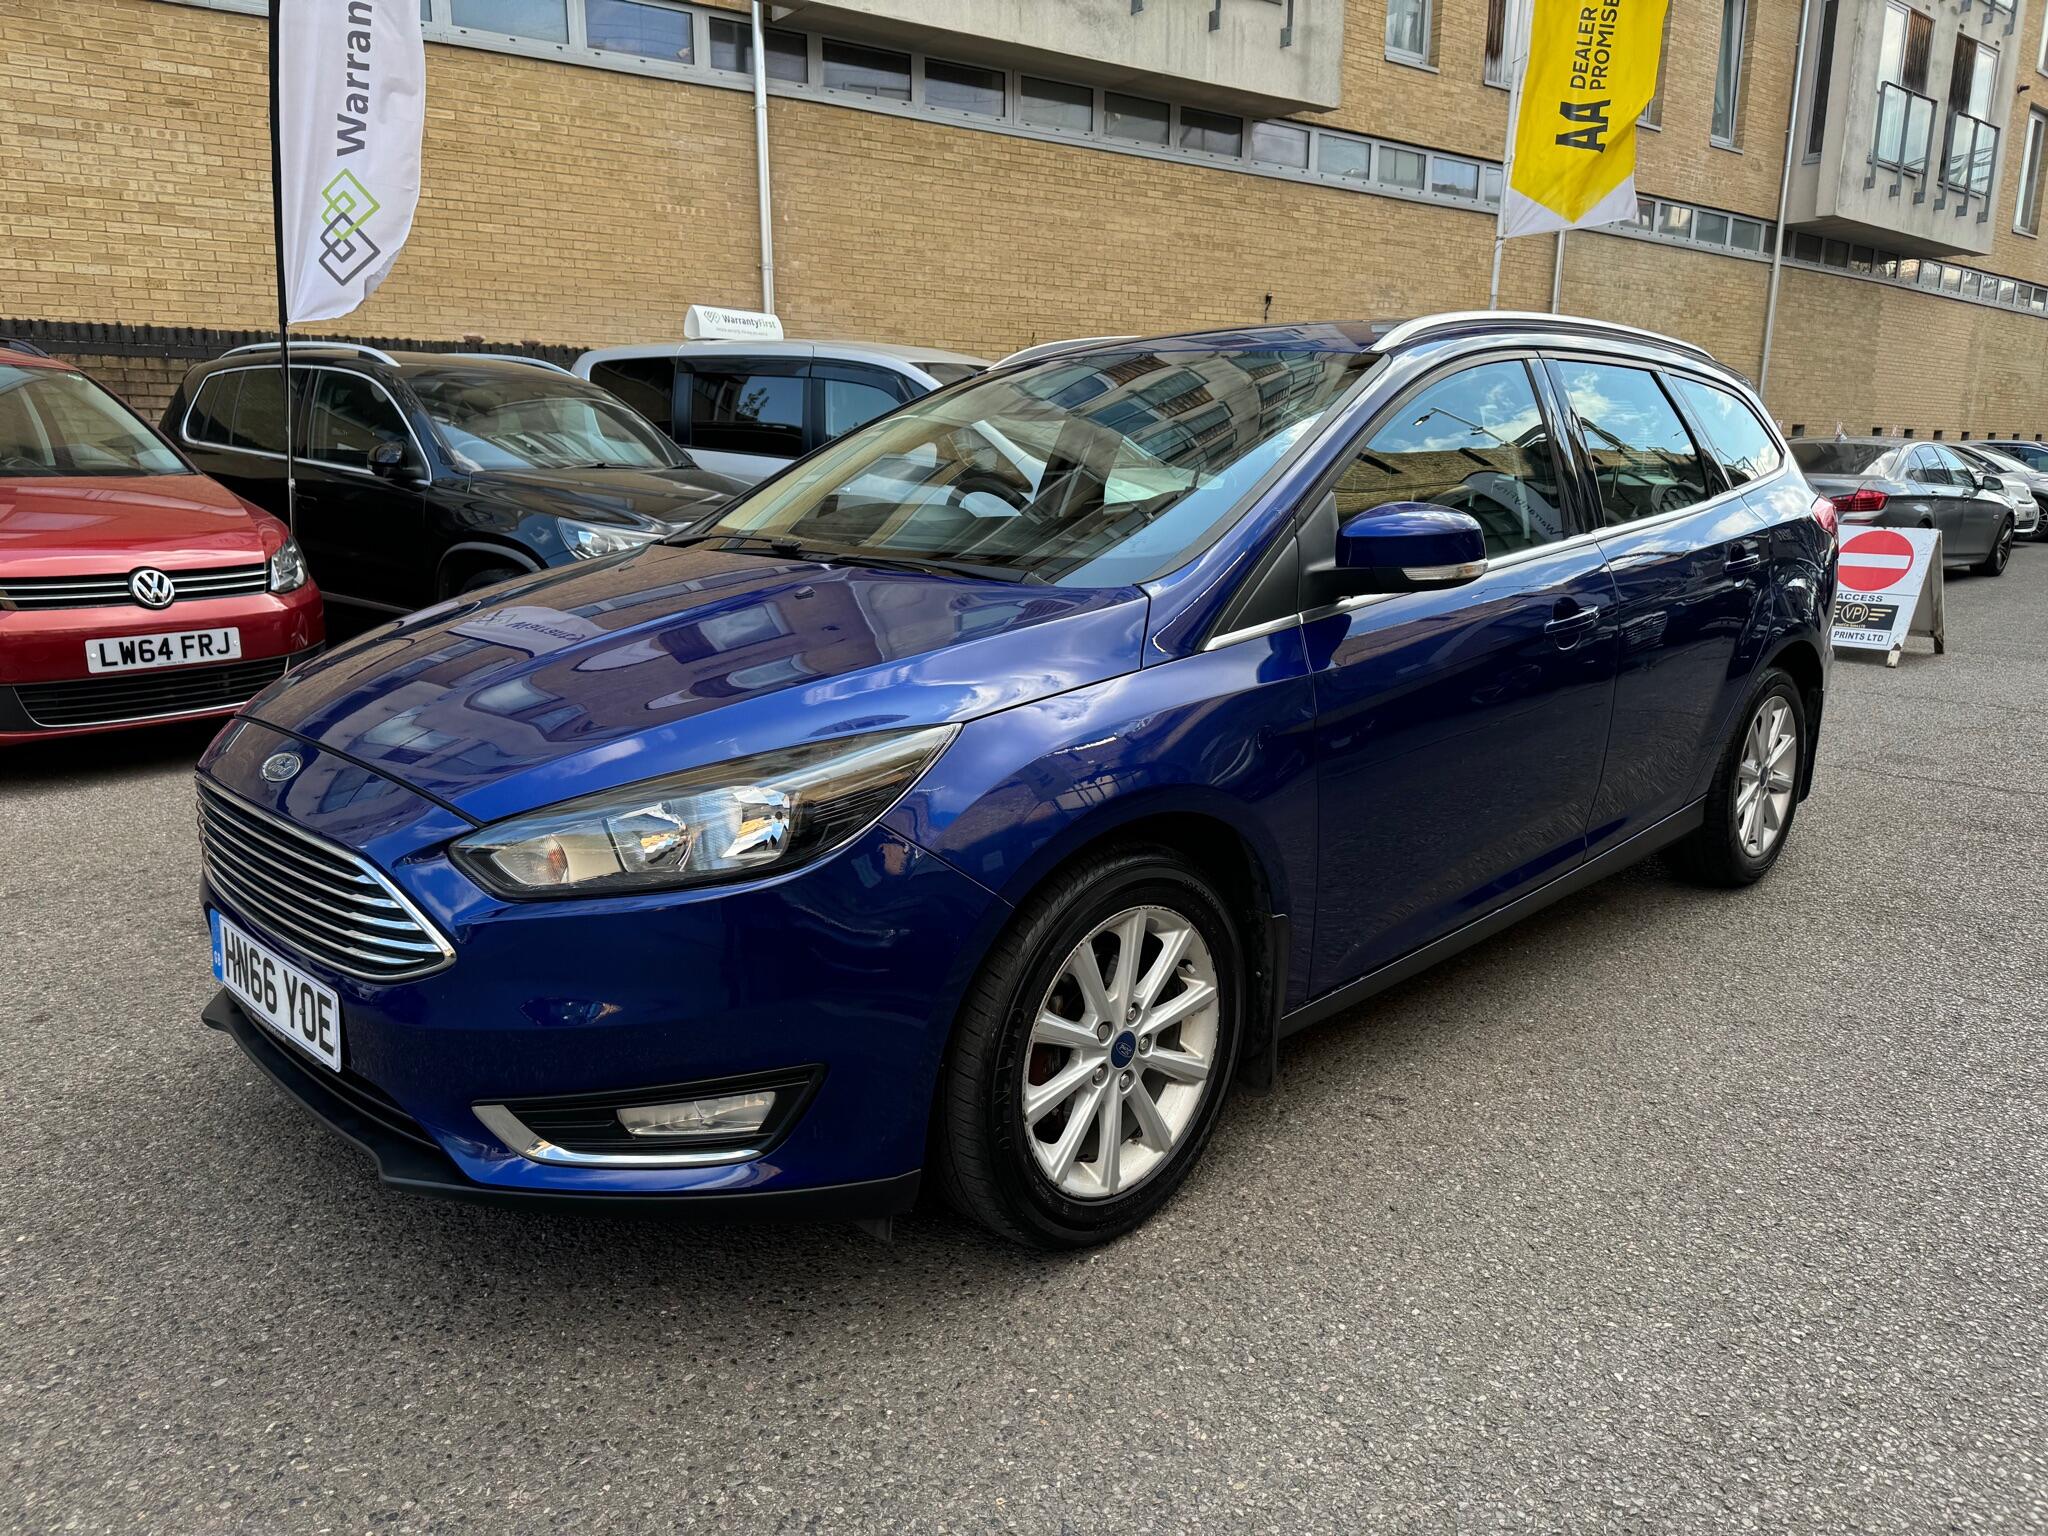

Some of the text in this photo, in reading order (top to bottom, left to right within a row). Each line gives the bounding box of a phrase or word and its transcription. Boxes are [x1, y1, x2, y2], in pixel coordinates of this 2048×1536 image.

[1570, 7, 1599, 90] DEALER
[1589, 0, 1620, 91] PROMISE
[337, 0, 373, 157] Warran
[1555, 98, 1612, 154] AA
[721, 313, 776, 329] WarrantyFirst
[1836, 593, 1884, 603] ACCESS
[1845, 606, 1867, 620] VPI
[98, 631, 231, 668] LW64 FRJ
[1833, 631, 1884, 642] PRINTS LTD
[223, 926, 335, 1056] HN66 YOE
